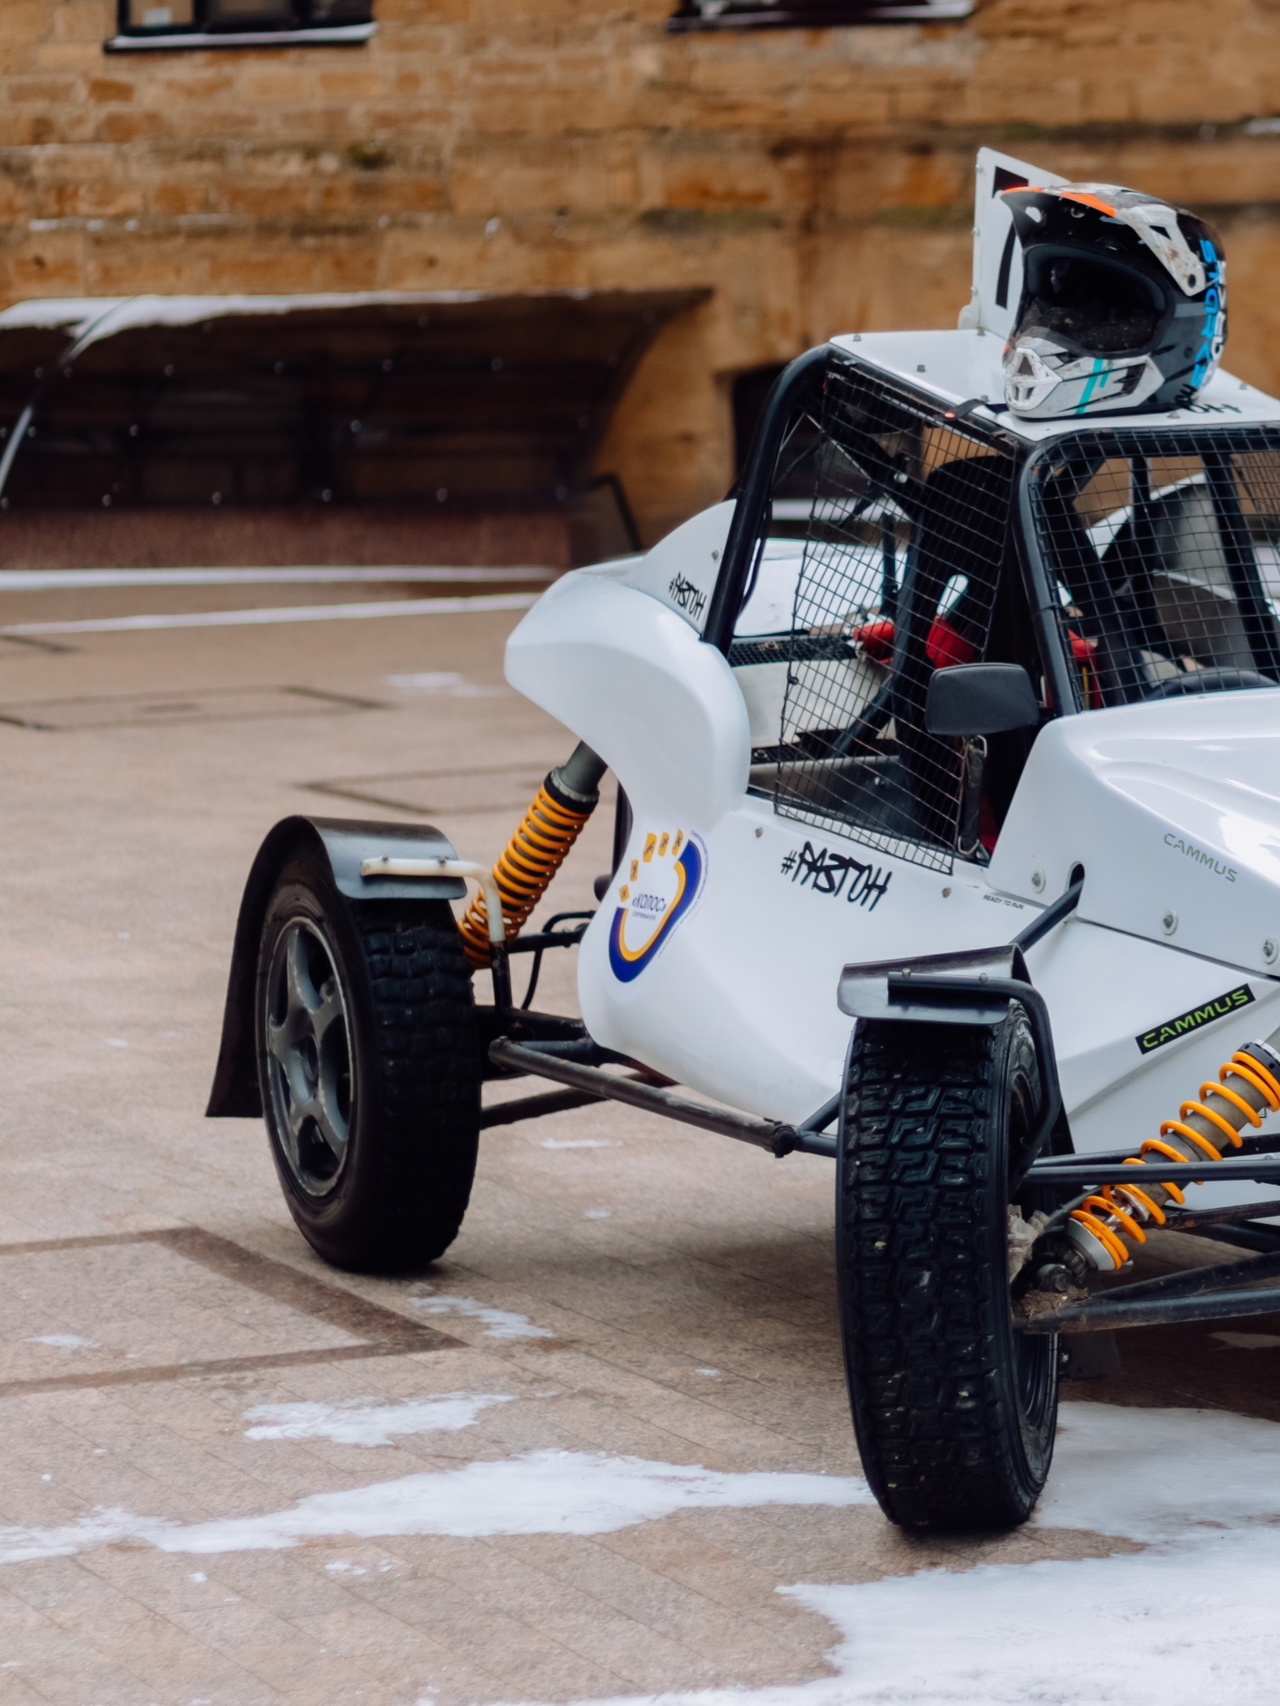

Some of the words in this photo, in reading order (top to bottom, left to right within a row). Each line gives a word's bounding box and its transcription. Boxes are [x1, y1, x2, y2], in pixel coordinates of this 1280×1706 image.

[780, 840, 893, 912] #РАЗГОН
[1163, 832, 1238, 883] CAMMUS
[1142, 988, 1249, 1048] CAMMUS
